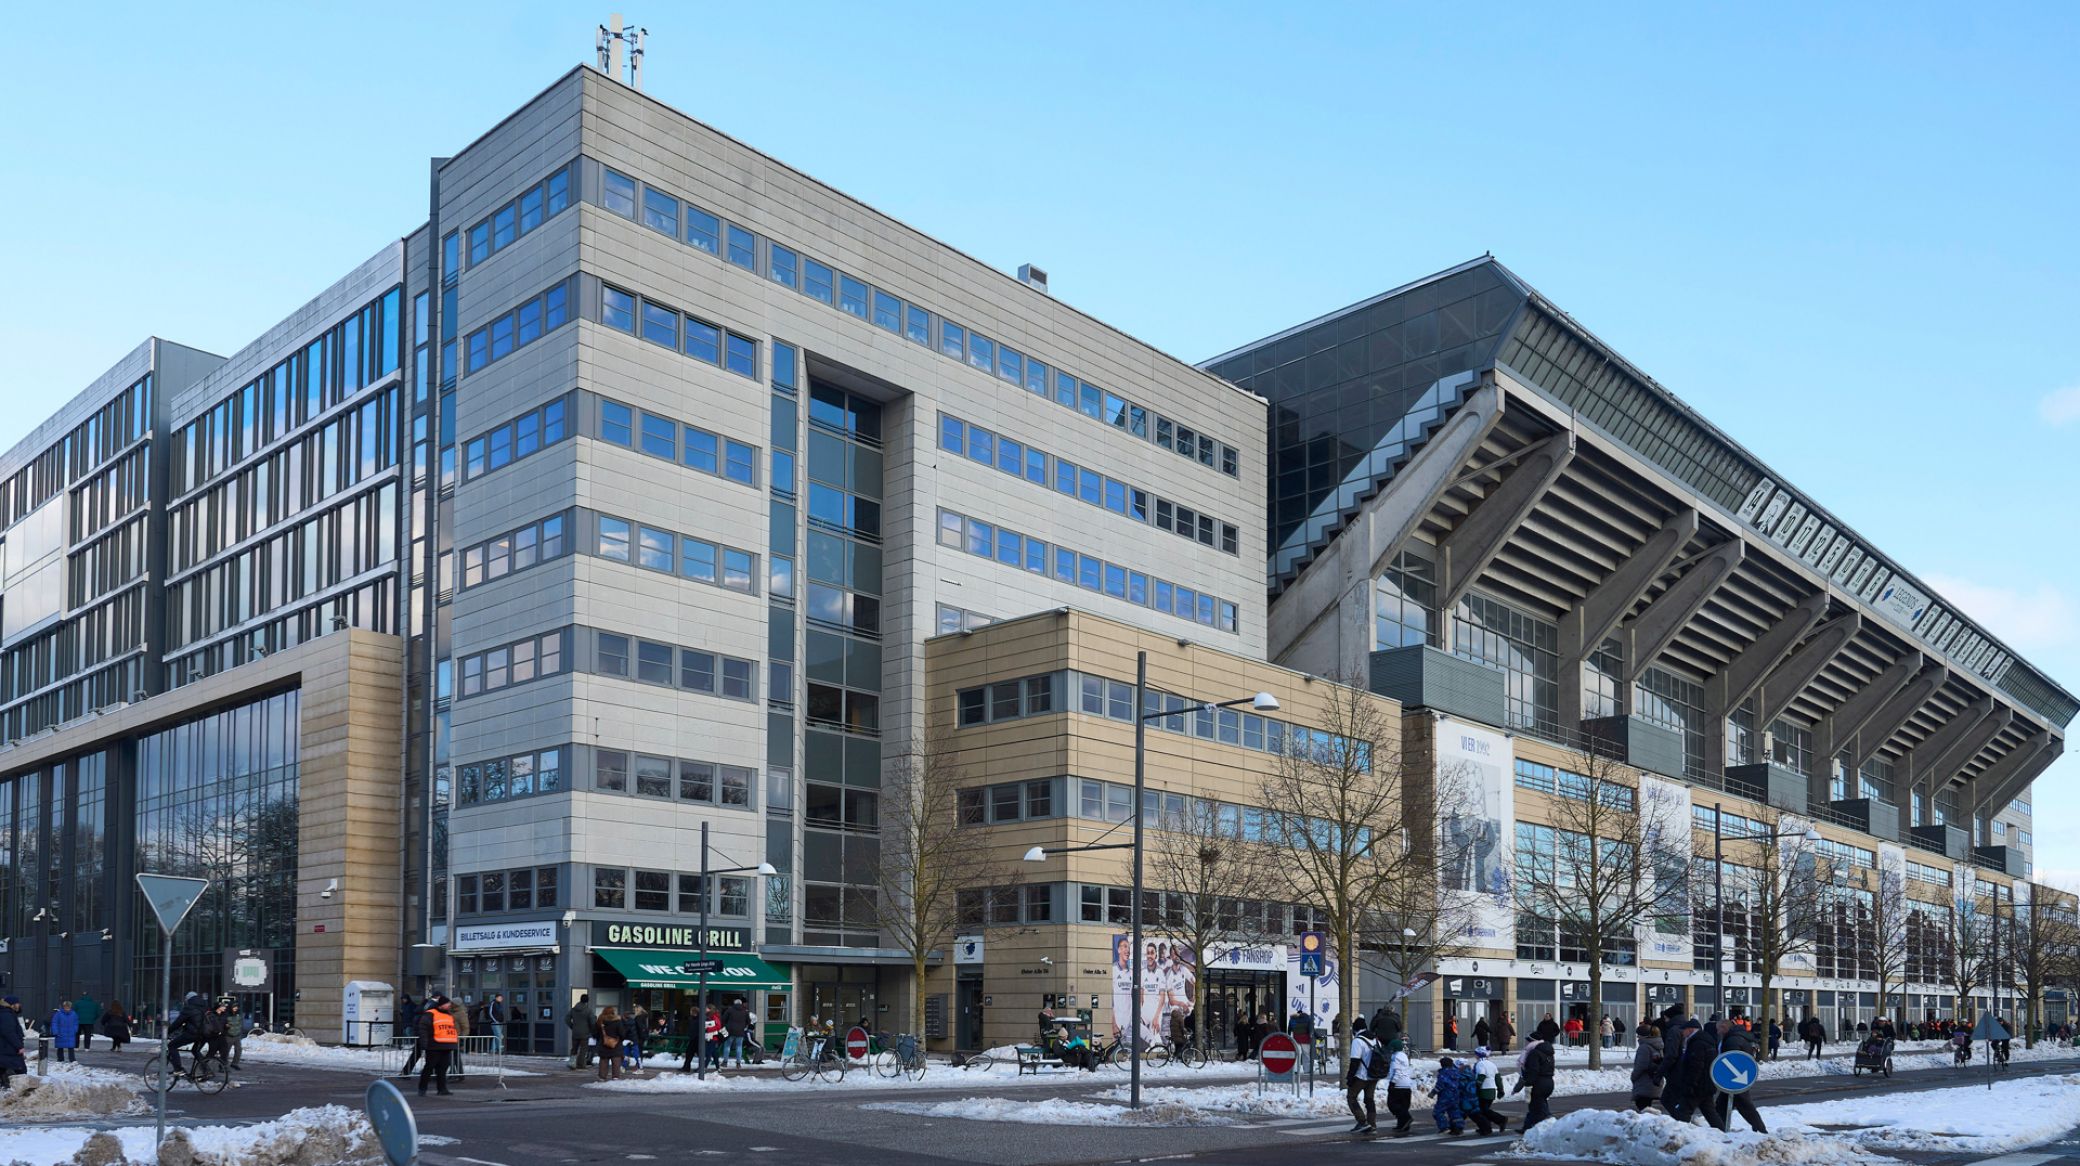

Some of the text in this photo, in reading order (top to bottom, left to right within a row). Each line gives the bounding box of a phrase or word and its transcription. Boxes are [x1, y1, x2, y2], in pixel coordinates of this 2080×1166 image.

[1747, 489, 1764, 511] 14
[1780, 514, 1796, 534] 10
[1797, 526, 1812, 545] 17
[1813, 536, 1827, 555] 12
[1893, 587, 1919, 610] LEGENDS
[1468, 737, 1475, 752] ER
[460, 928, 551, 942] BILLETSALG & KUNDESERVICE
[608, 924, 693, 945] GASOLINE
[1242, 949, 1274, 964] FANSHOP
[639, 964, 678, 975] WE
[722, 967, 757, 977] YOU
